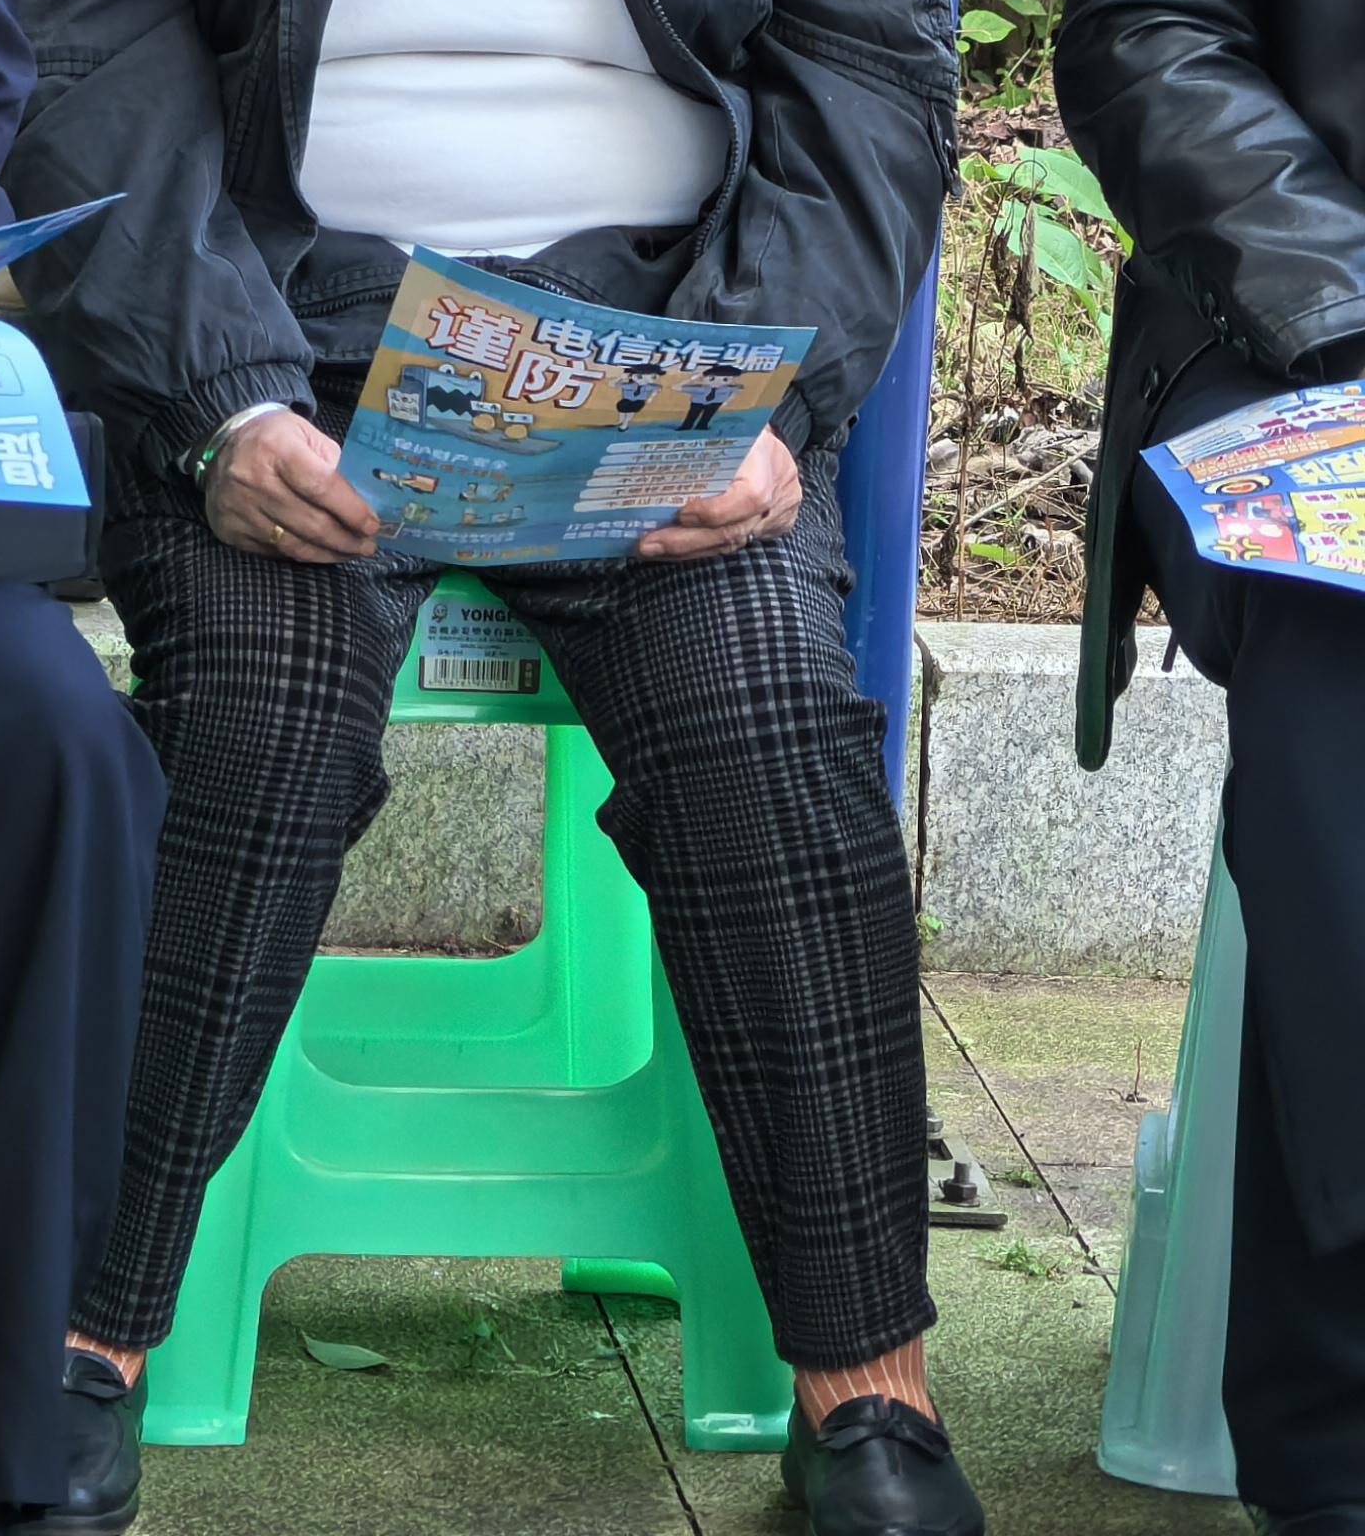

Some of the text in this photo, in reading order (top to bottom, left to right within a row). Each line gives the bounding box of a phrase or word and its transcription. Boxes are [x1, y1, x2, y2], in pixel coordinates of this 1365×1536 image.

[428, 296, 605, 408] 谨防
[537, 318, 784, 372] 电信诈骗
